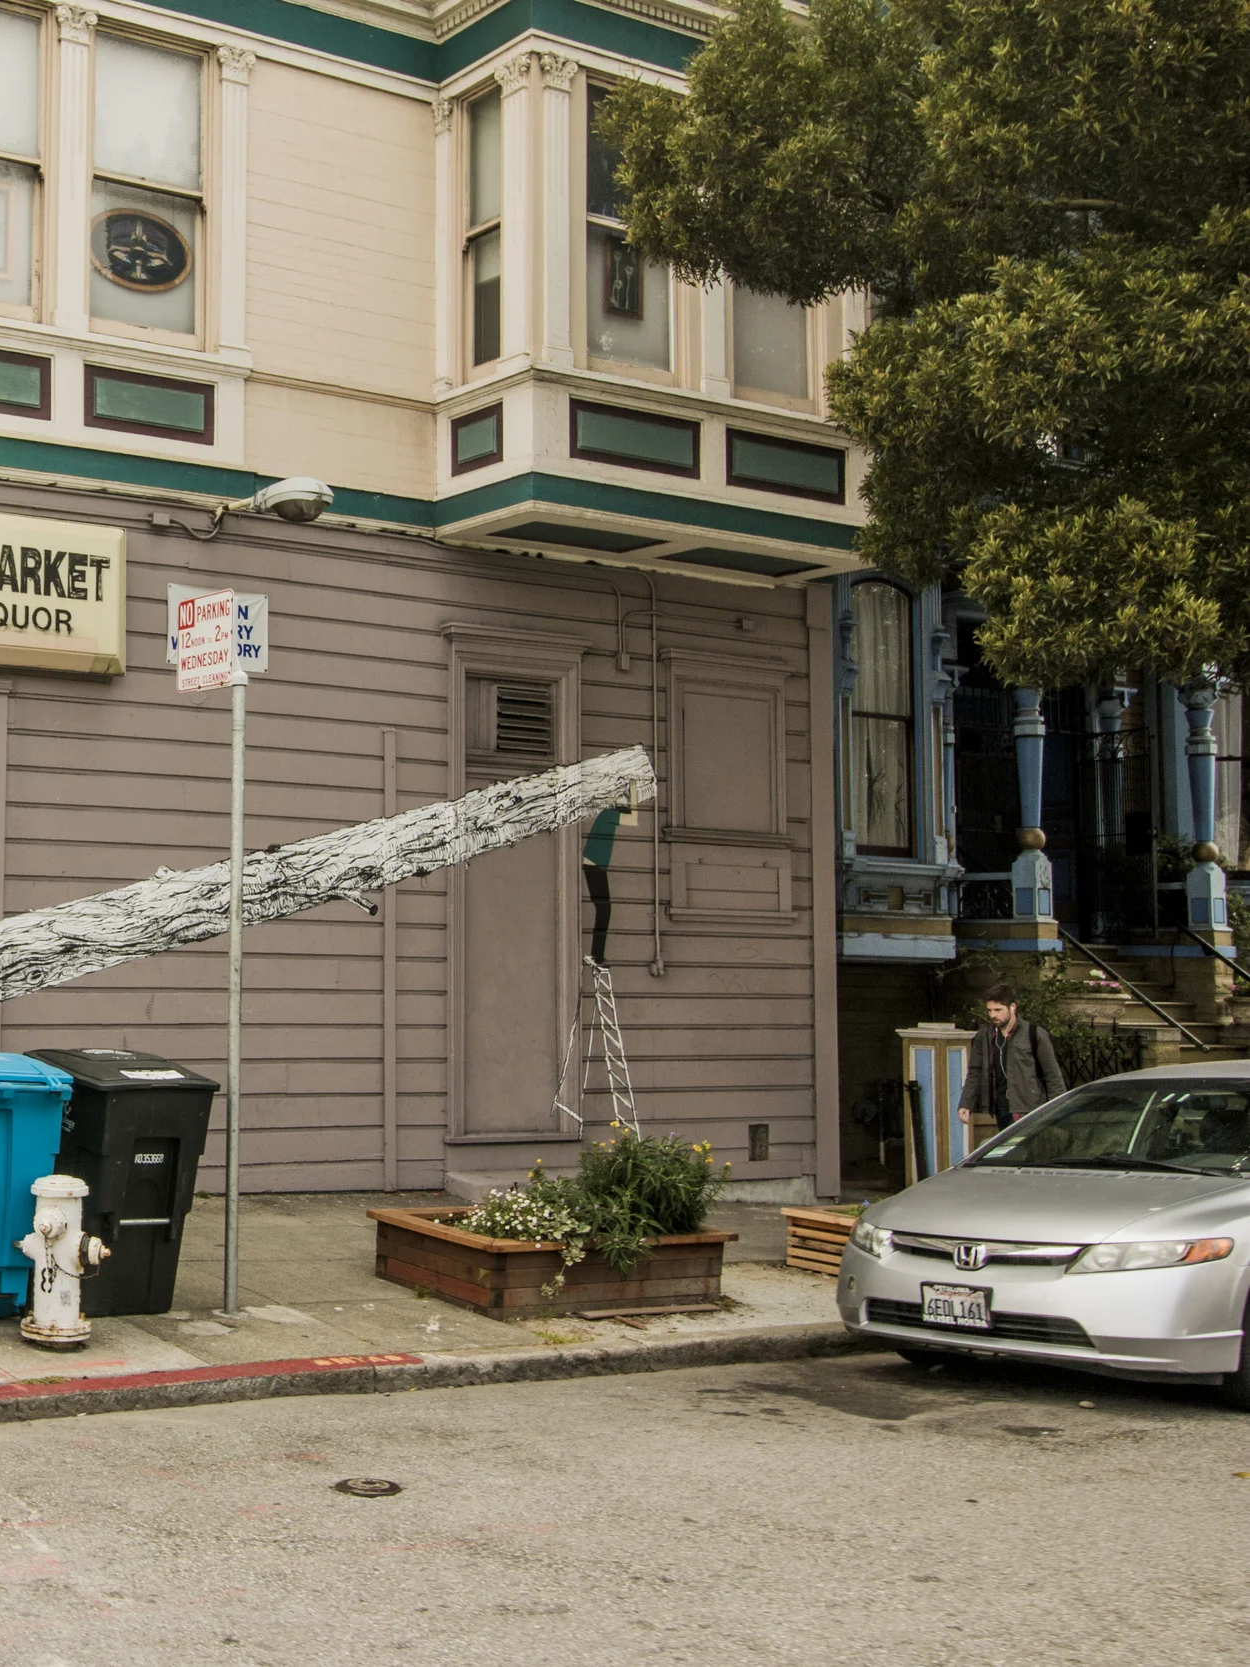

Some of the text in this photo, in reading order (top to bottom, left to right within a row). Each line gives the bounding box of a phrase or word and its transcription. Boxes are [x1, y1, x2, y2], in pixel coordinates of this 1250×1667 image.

[179, 602, 194, 628] NO
[196, 599, 230, 623] PARKING
[181, 648, 229, 671] WEDNESDAY
[181, 676, 200, 689] STREET
